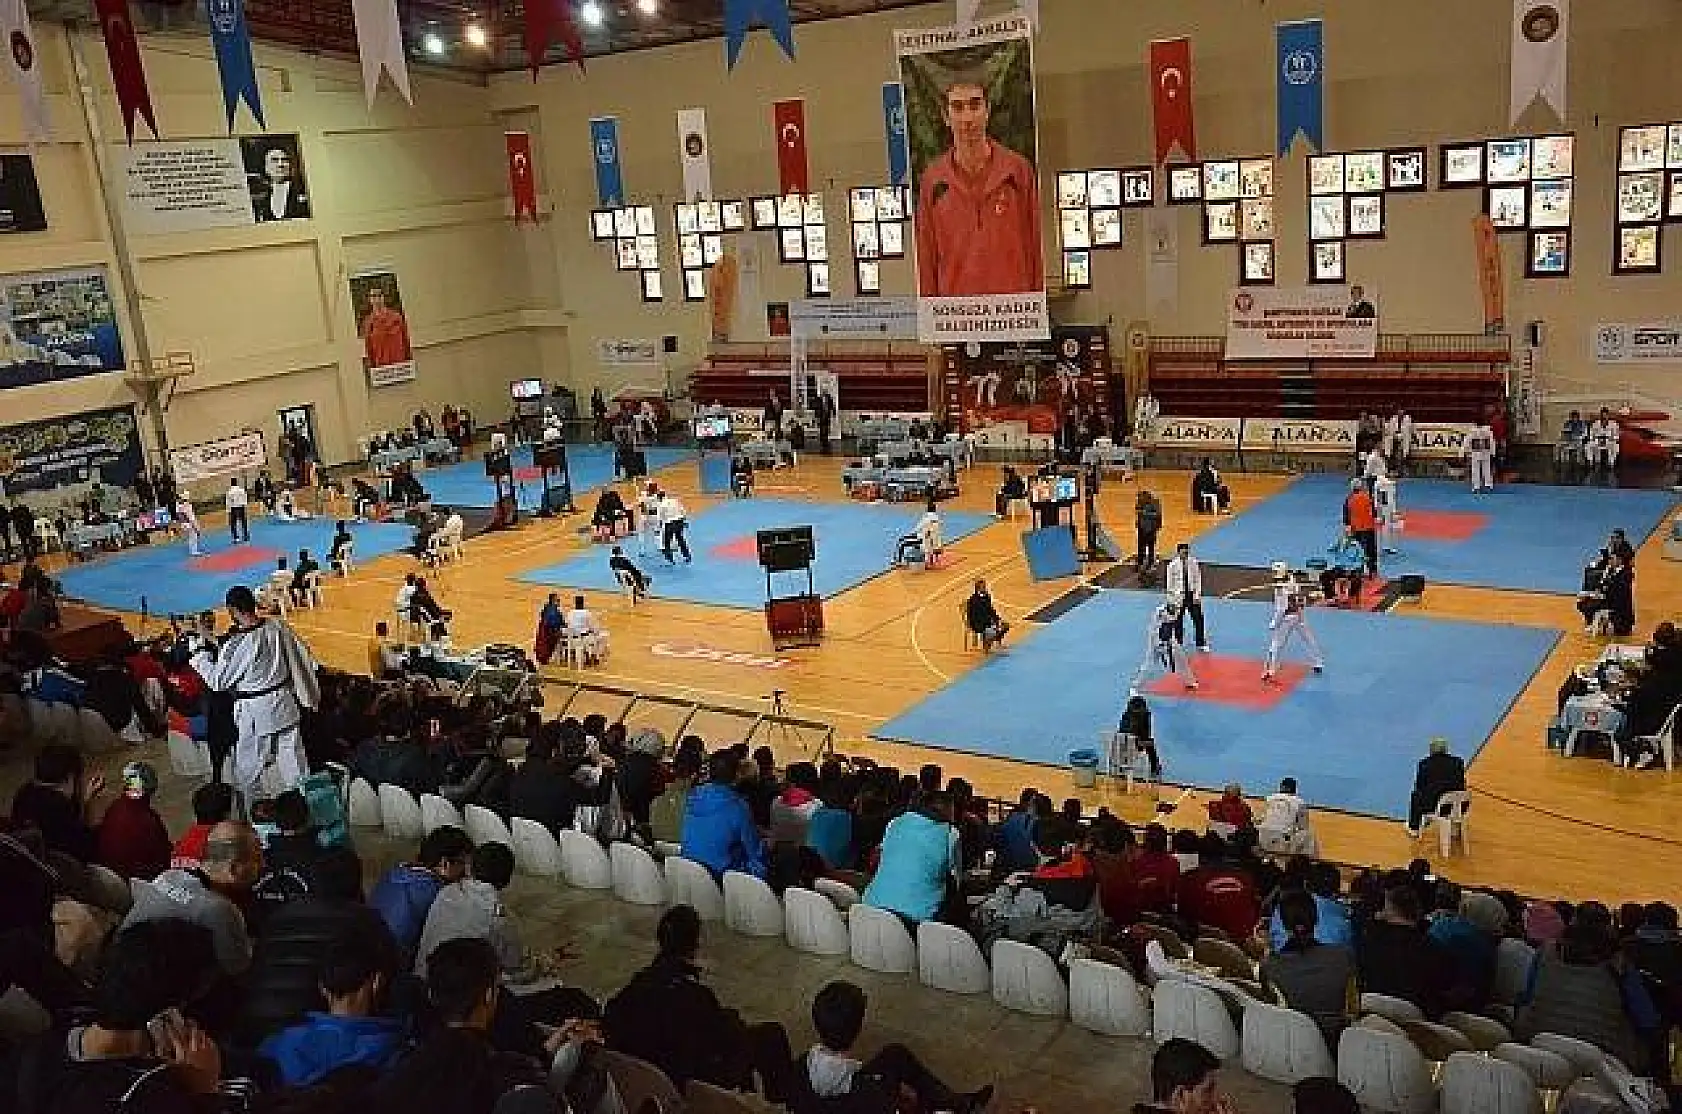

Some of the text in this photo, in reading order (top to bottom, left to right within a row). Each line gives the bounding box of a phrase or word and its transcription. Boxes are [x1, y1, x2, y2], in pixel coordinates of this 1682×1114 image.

[1161, 427, 1235, 440] ALANYA
[1271, 427, 1352, 442] ALANYA
[1411, 432, 1466, 447] ALAN
